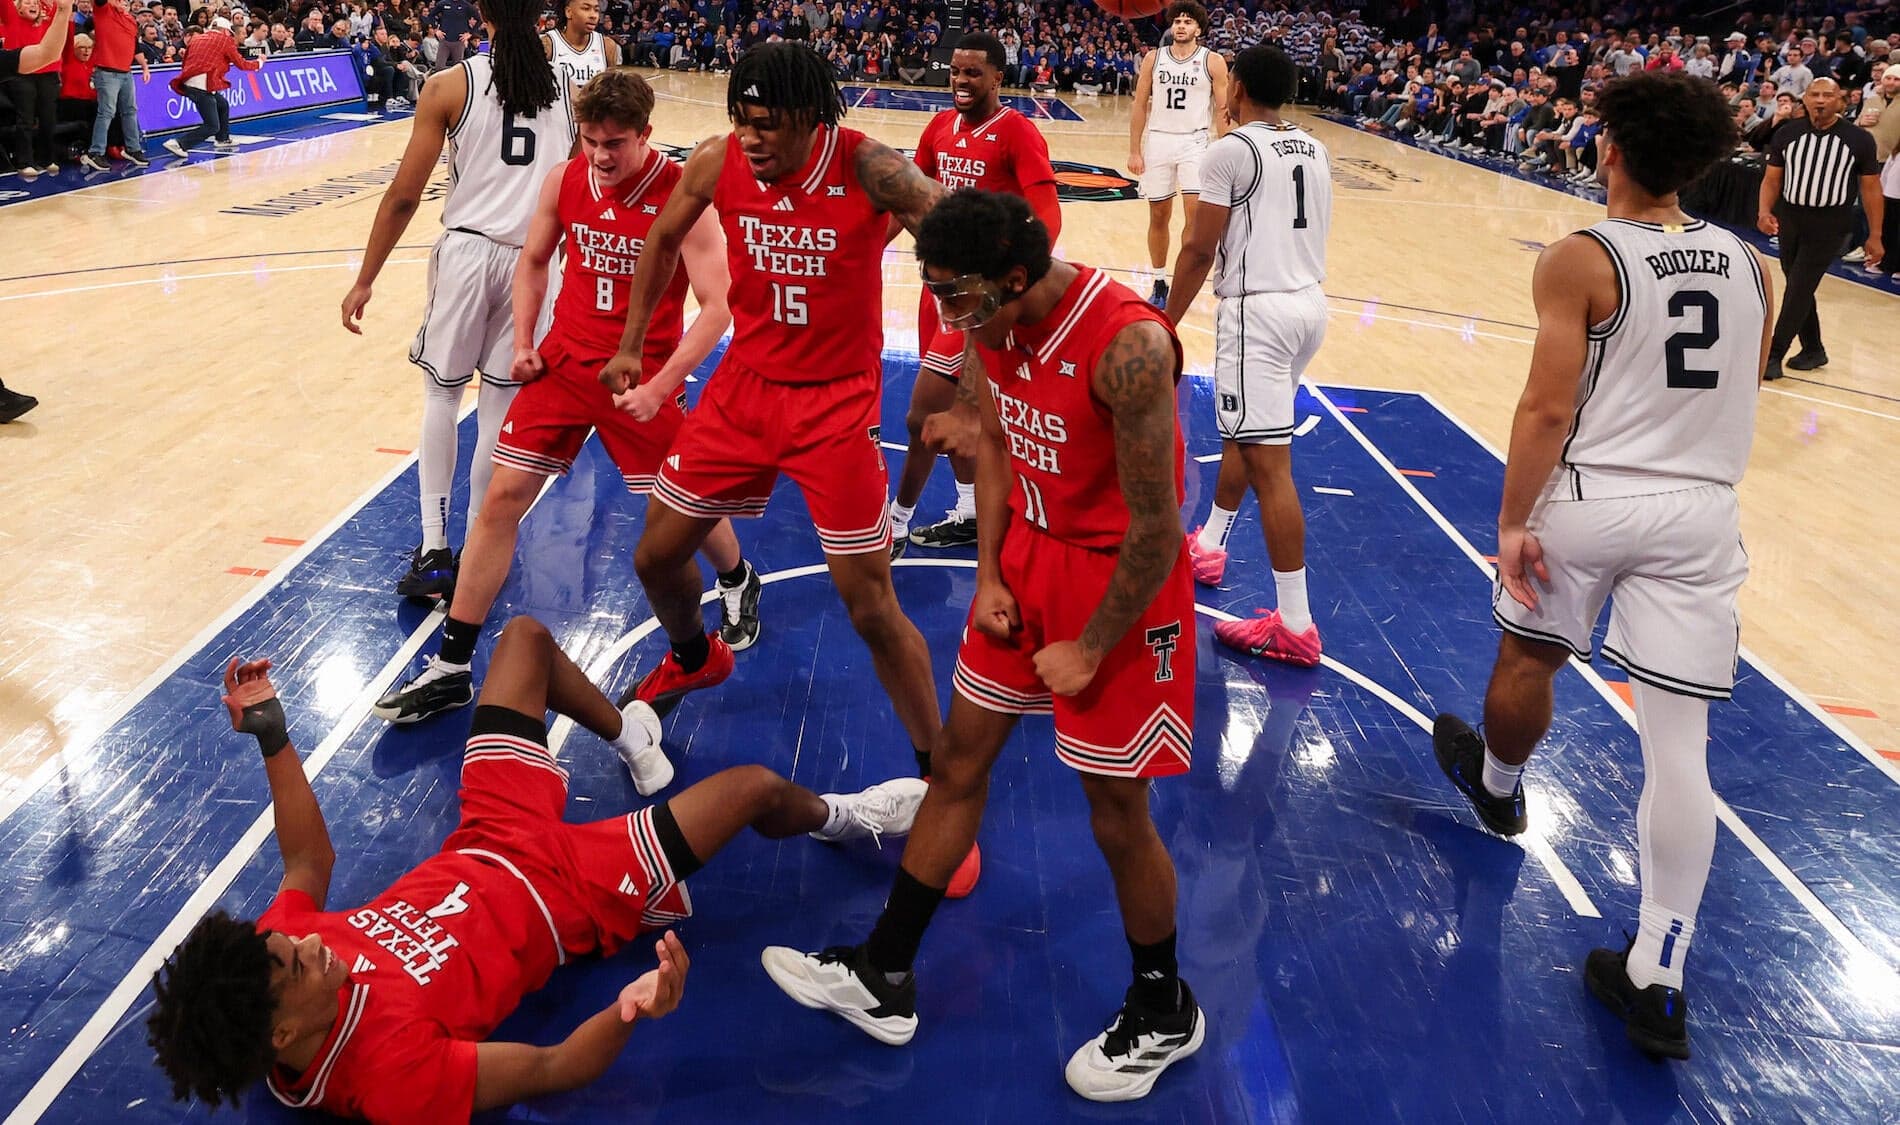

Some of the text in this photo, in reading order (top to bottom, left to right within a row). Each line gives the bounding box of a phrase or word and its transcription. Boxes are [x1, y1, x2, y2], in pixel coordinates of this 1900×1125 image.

[264, 67, 338, 100] ULTRA
[560, 62, 600, 81] Duk
[1159, 70, 1198, 86] Duke
[1166, 87, 1186, 109] 12
[501, 101, 537, 166] 6
[1270, 139, 1316, 160] FOSTER
[938, 151, 986, 177] TEXAS
[1292, 164, 1307, 229] 1
[571, 222, 645, 257] TEXAS
[739, 215, 837, 251] TEXAS
[580, 245, 636, 275] TECH
[748, 244, 826, 276] TECH
[1645, 249, 1730, 280] BOOZER
[596, 276, 614, 312] 8
[771, 282, 808, 325] 15
[1665, 290, 1720, 389] 2
[987, 376, 1068, 444] TEXAS
[1018, 472, 1048, 530] 11
[425, 881, 470, 918] 4
[347, 909, 441, 986] TEXAS
[382, 900, 460, 964] TECH
